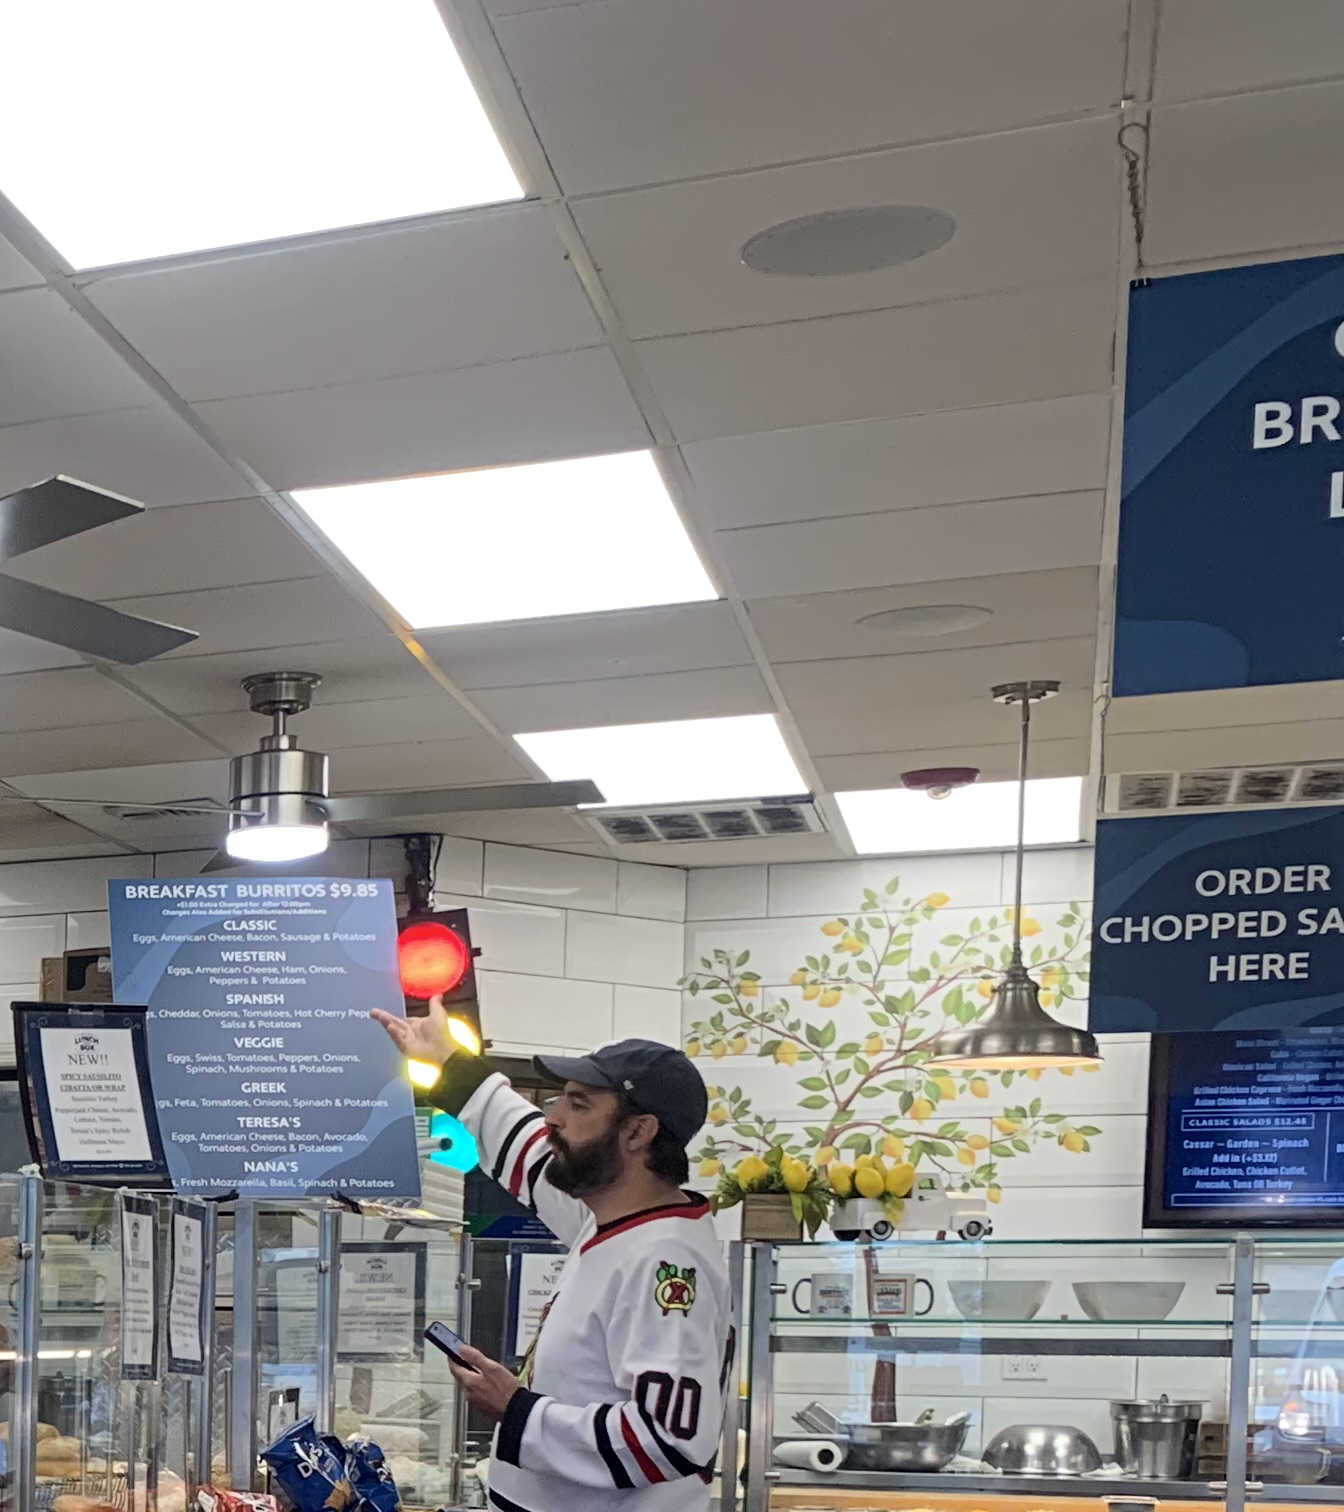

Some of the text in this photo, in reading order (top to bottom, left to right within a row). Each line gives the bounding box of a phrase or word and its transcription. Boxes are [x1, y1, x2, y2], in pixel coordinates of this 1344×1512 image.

[1194, 864, 1332, 898] ORDER
[125, 884, 379, 899] BREAKFAST BURRITOS $9.85
[223, 920, 277, 931] CLASSIC
[1100, 910, 1287, 945] CHOPPED
[221, 951, 286, 962] WESTERN
[1209, 952, 1311, 982] HERE
[226, 994, 285, 1005] SPANISH
[234, 1037, 284, 1048] VEGGIE
[241, 1082, 286, 1093] GREEK
[237, 1116, 301, 1128] TERESA'S
[244, 1161, 299, 1172] NANA'S
